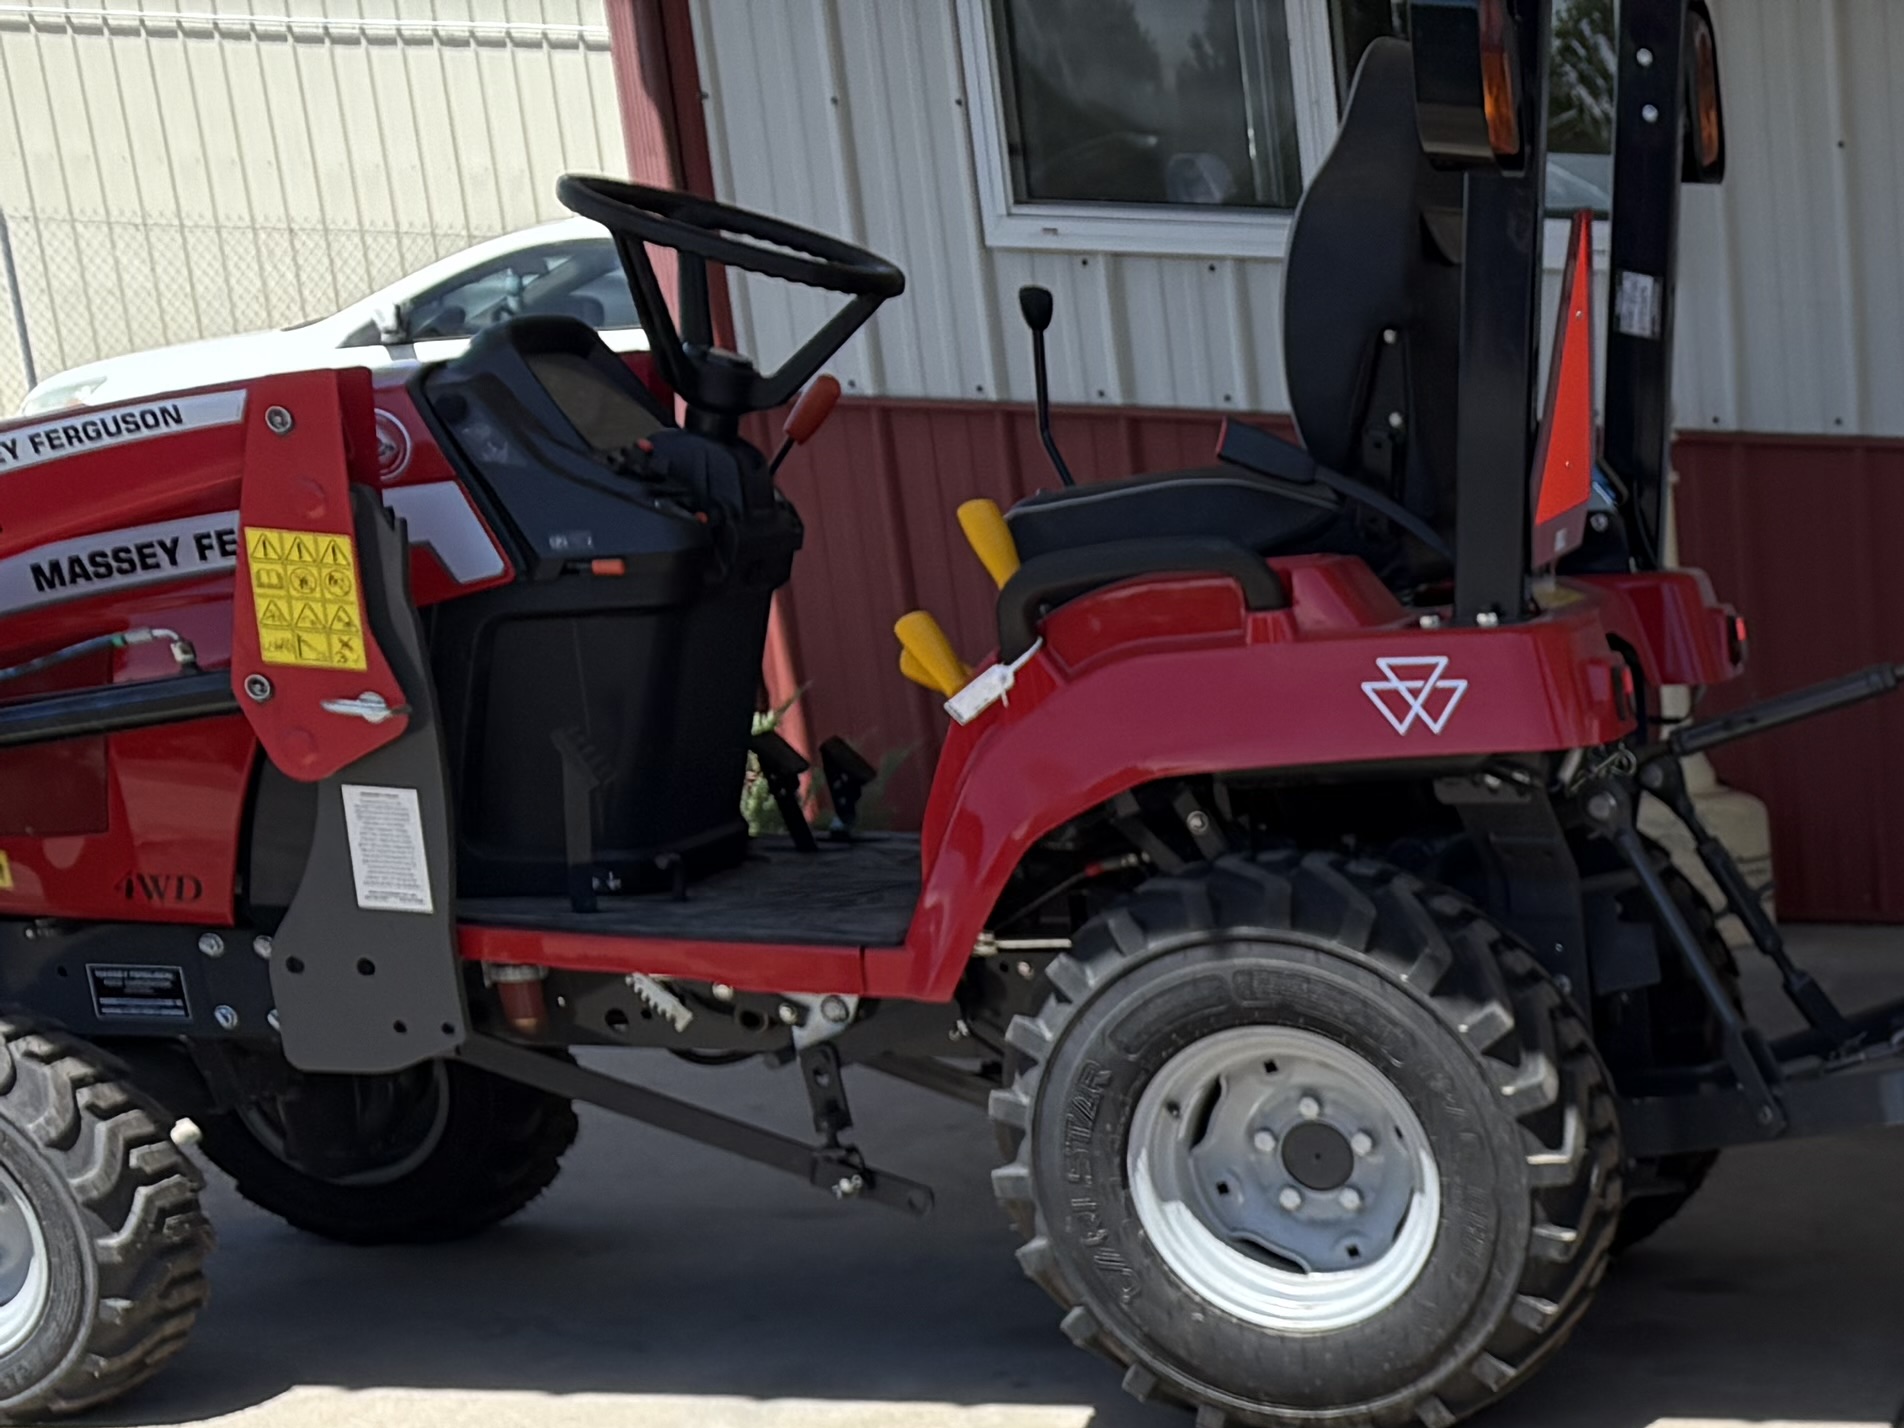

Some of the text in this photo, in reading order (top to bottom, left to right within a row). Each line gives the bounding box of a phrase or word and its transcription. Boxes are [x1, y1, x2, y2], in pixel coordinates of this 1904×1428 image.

[29, 404, 184, 455] FERGUSON
[30, 536, 180, 593] MASSEY
[117, 869, 204, 902] 4WD
